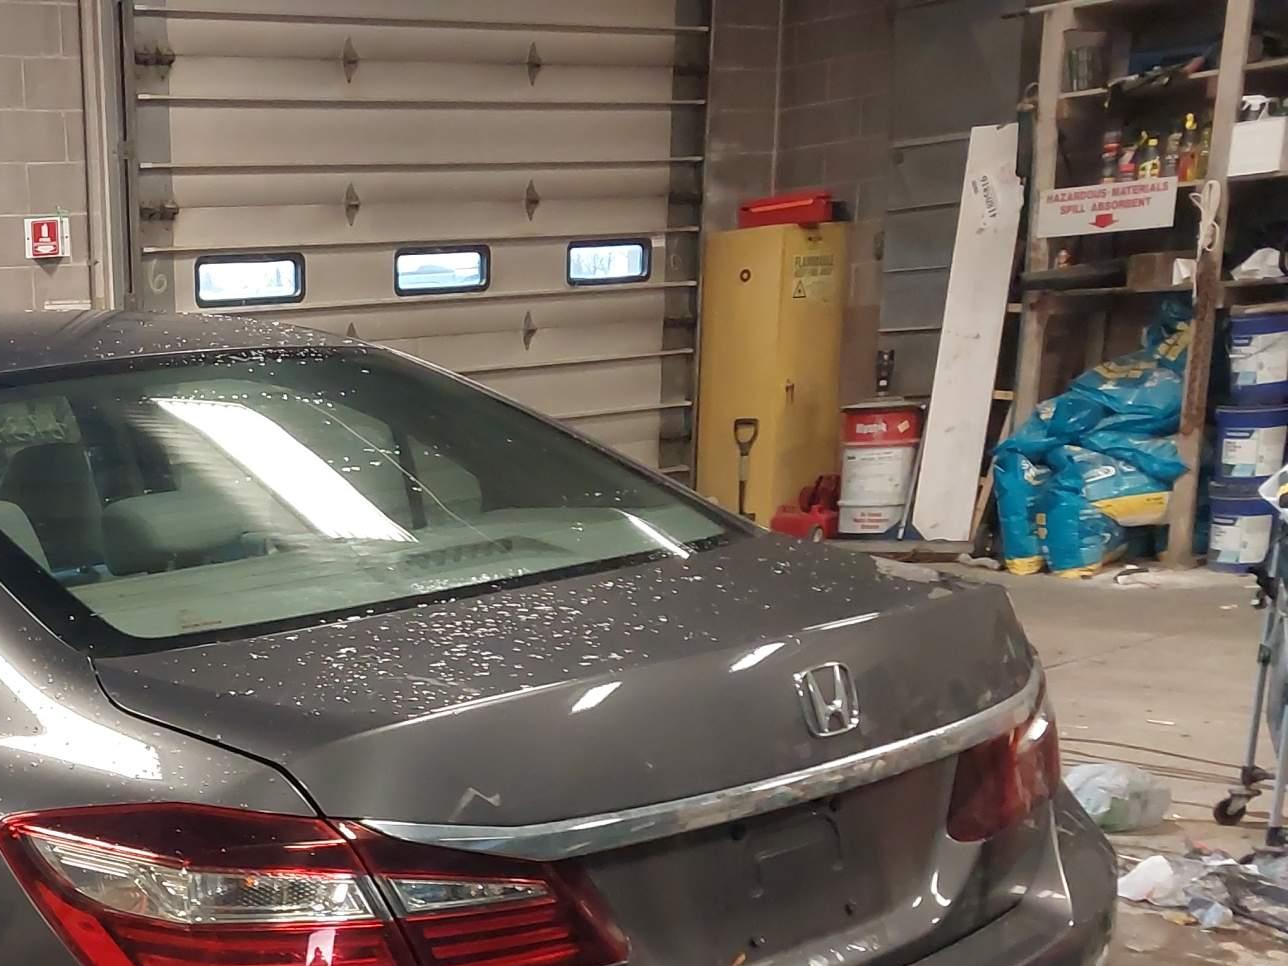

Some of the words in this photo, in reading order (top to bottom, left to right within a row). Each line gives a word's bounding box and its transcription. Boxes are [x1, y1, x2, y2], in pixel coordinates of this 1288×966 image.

[1047, 188, 1107, 203] HAZARDOUS
[1112, 181, 1169, 196] MATERIALS
[1060, 204, 1085, 215] SPILL
[1091, 197, 1152, 211] ABSORBENT
[148, 259, 167, 293] 6
